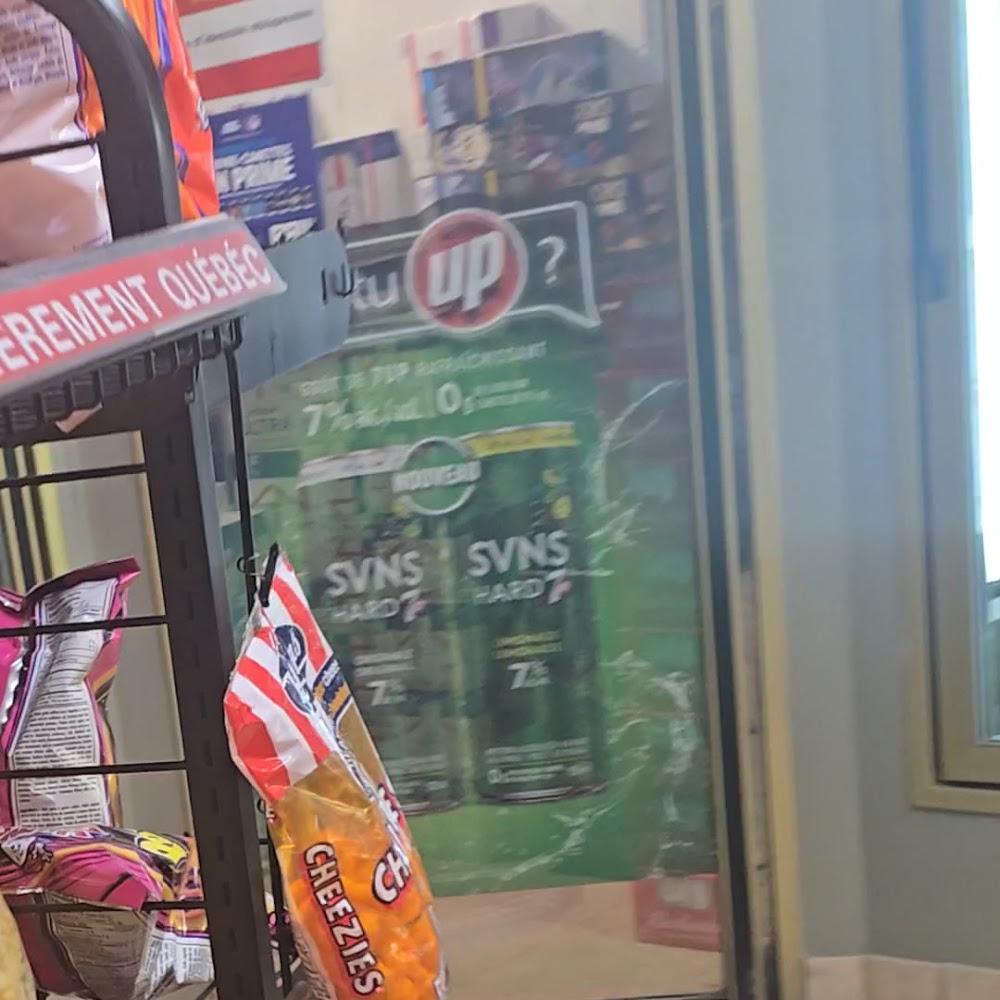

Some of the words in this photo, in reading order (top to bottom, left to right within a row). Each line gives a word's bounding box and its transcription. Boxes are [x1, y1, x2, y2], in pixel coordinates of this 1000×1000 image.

[160, 241, 272, 308] QUÉBÉC
[428, 231, 505, 312] up
[325, 551, 424, 598] SVNS
[466, 530, 570, 578] SVNS
[303, 842, 385, 997] CHEEZIES
